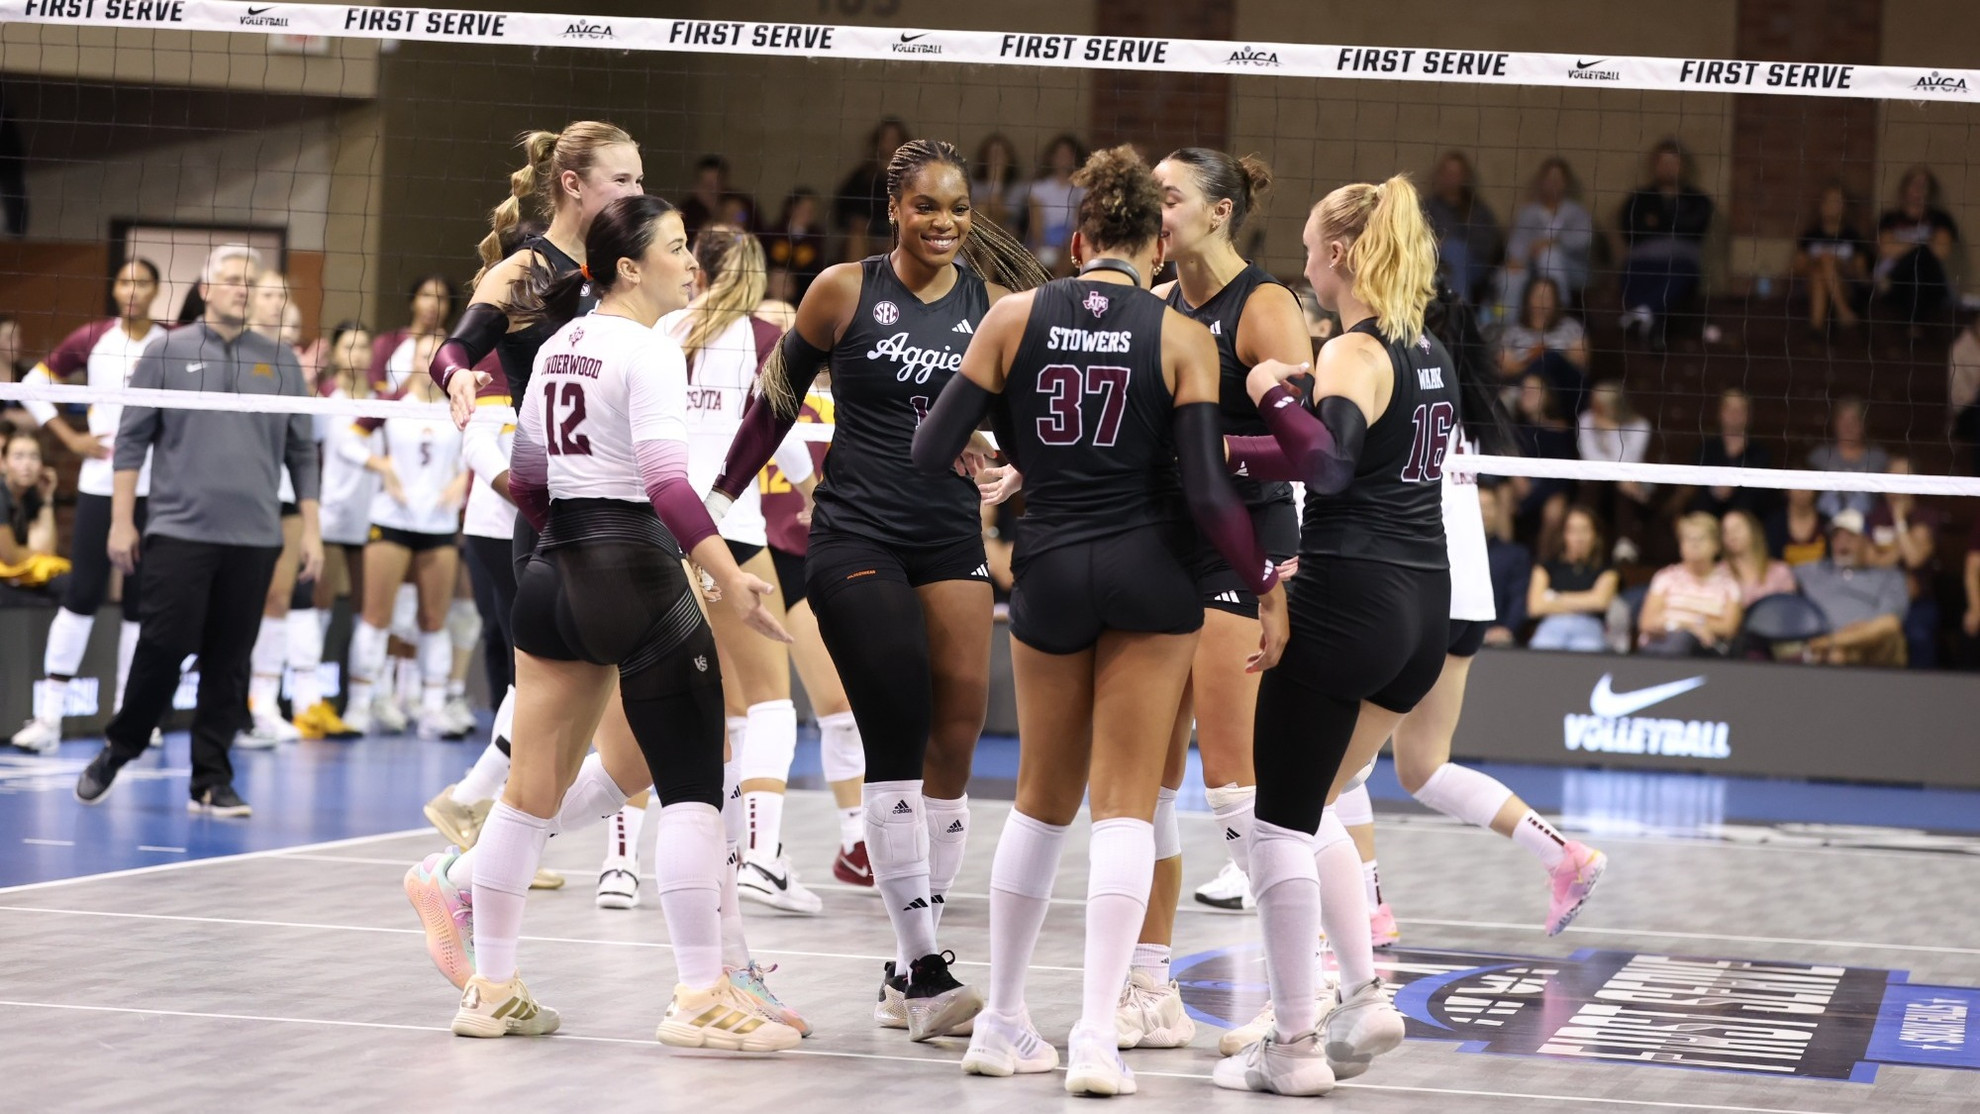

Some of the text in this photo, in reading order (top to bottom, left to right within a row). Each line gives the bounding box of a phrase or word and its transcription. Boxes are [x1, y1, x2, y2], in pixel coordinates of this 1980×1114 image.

[25, 0, 185, 22] FIRST SERVE
[239, 16, 289, 27] VOLLEYBALL
[345, 8, 508, 37] FIRST SERVE
[563, 24, 614, 39] AVCA
[670, 21, 836, 50] FIRST SERVE
[892, 43, 942, 54] VOLLEYBALL
[1001, 34, 1169, 64] FIRST SERVE
[1227, 51, 1279, 67] AVCA
[1337, 48, 1509, 77] FIRST SERVE
[1567, 69, 1620, 81] VOLLEYBALL
[1679, 60, 1855, 89] FIRST SERVE
[1913, 77, 1967, 93] AVCA
[874, 302, 899, 325] SEC
[1047, 326, 1132, 353] STOWERS
[866, 332, 963, 385] Aggie
[1417, 367, 1445, 391] WAAK
[543, 382, 593, 456] 12
[1036, 364, 1131, 447] 37
[419, 441, 432, 466] 5
[1401, 401, 1454, 482] 16
[1563, 713, 1732, 759] VOLLEYBALL
[1536, 955, 1846, 1073] FIRST SERVE
[1904, 1003, 1969, 1024] FALLS
